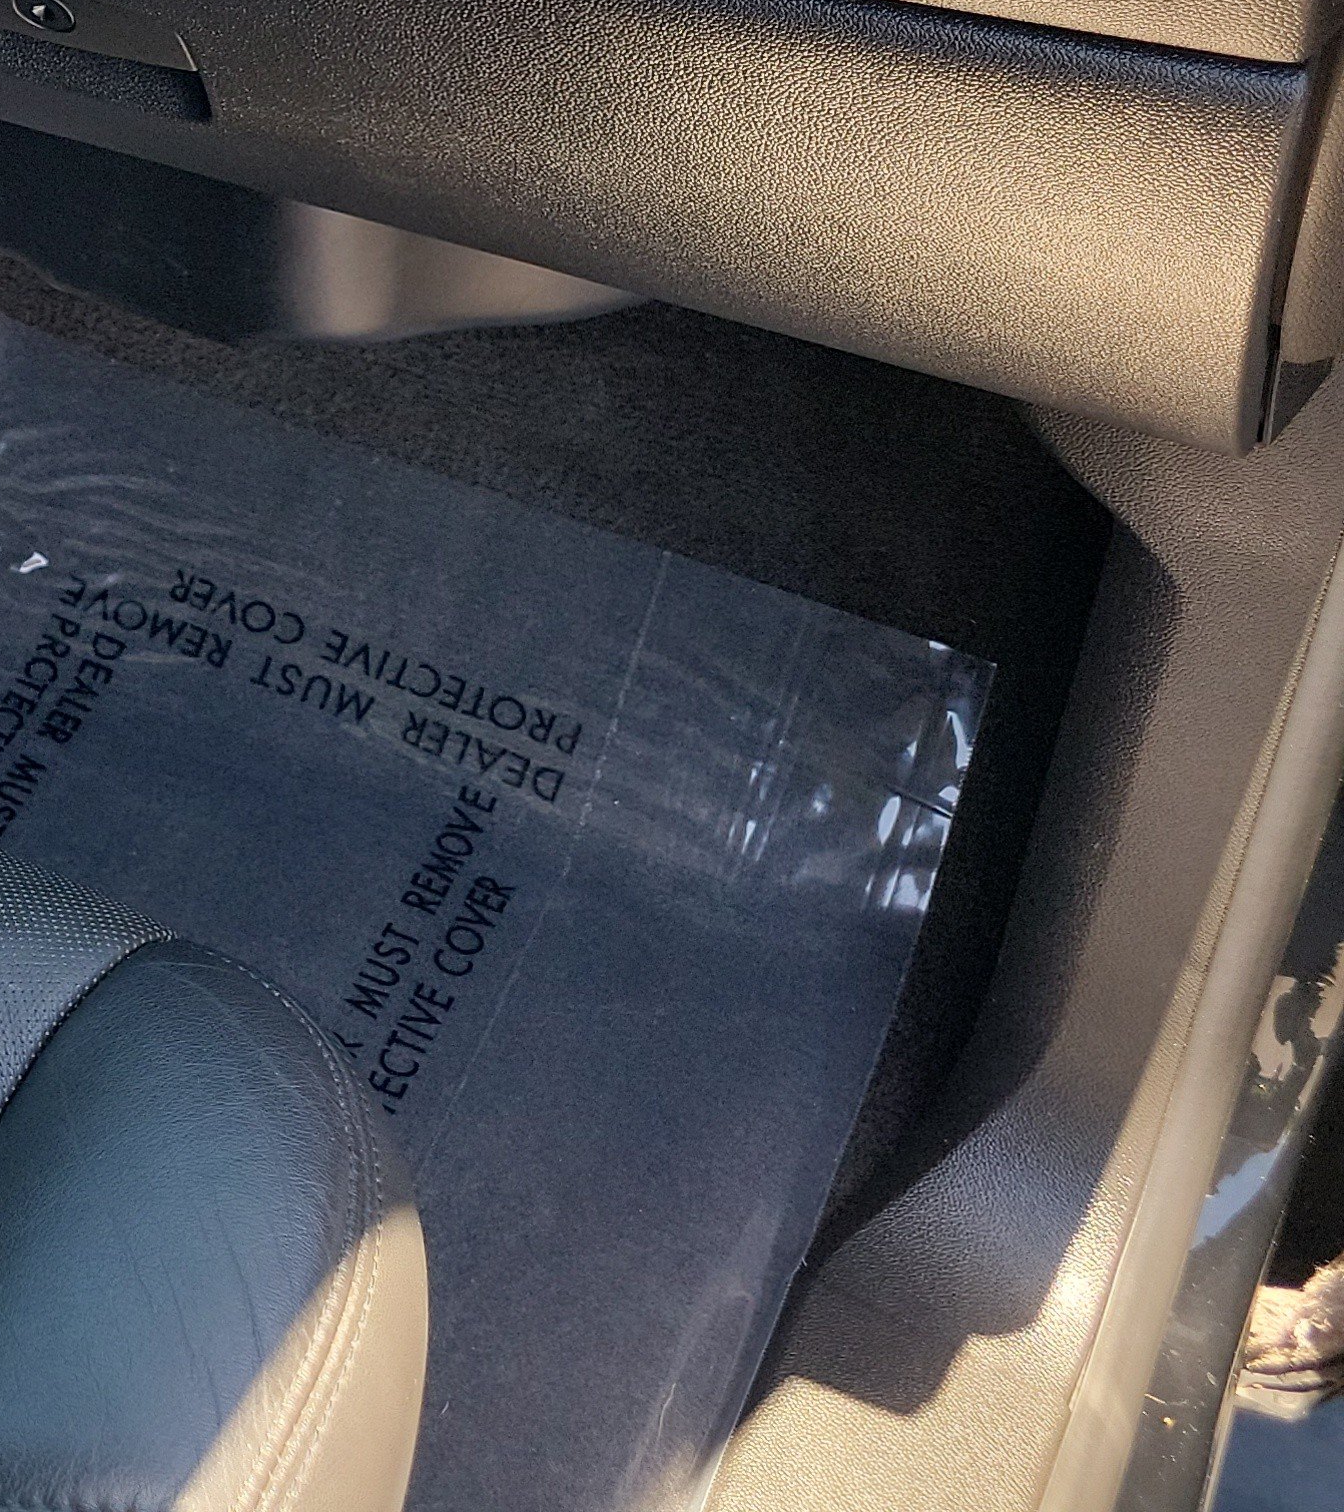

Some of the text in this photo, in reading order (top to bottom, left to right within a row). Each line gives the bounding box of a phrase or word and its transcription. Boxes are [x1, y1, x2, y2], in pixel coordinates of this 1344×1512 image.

[59, 573, 565, 802] DEALER MUST REMOVE
[169, 569, 583, 754] PROTECTIVE COVER
[343, 785, 497, 1020] MUST REMOVE
[433, 875, 515, 978] COVER
